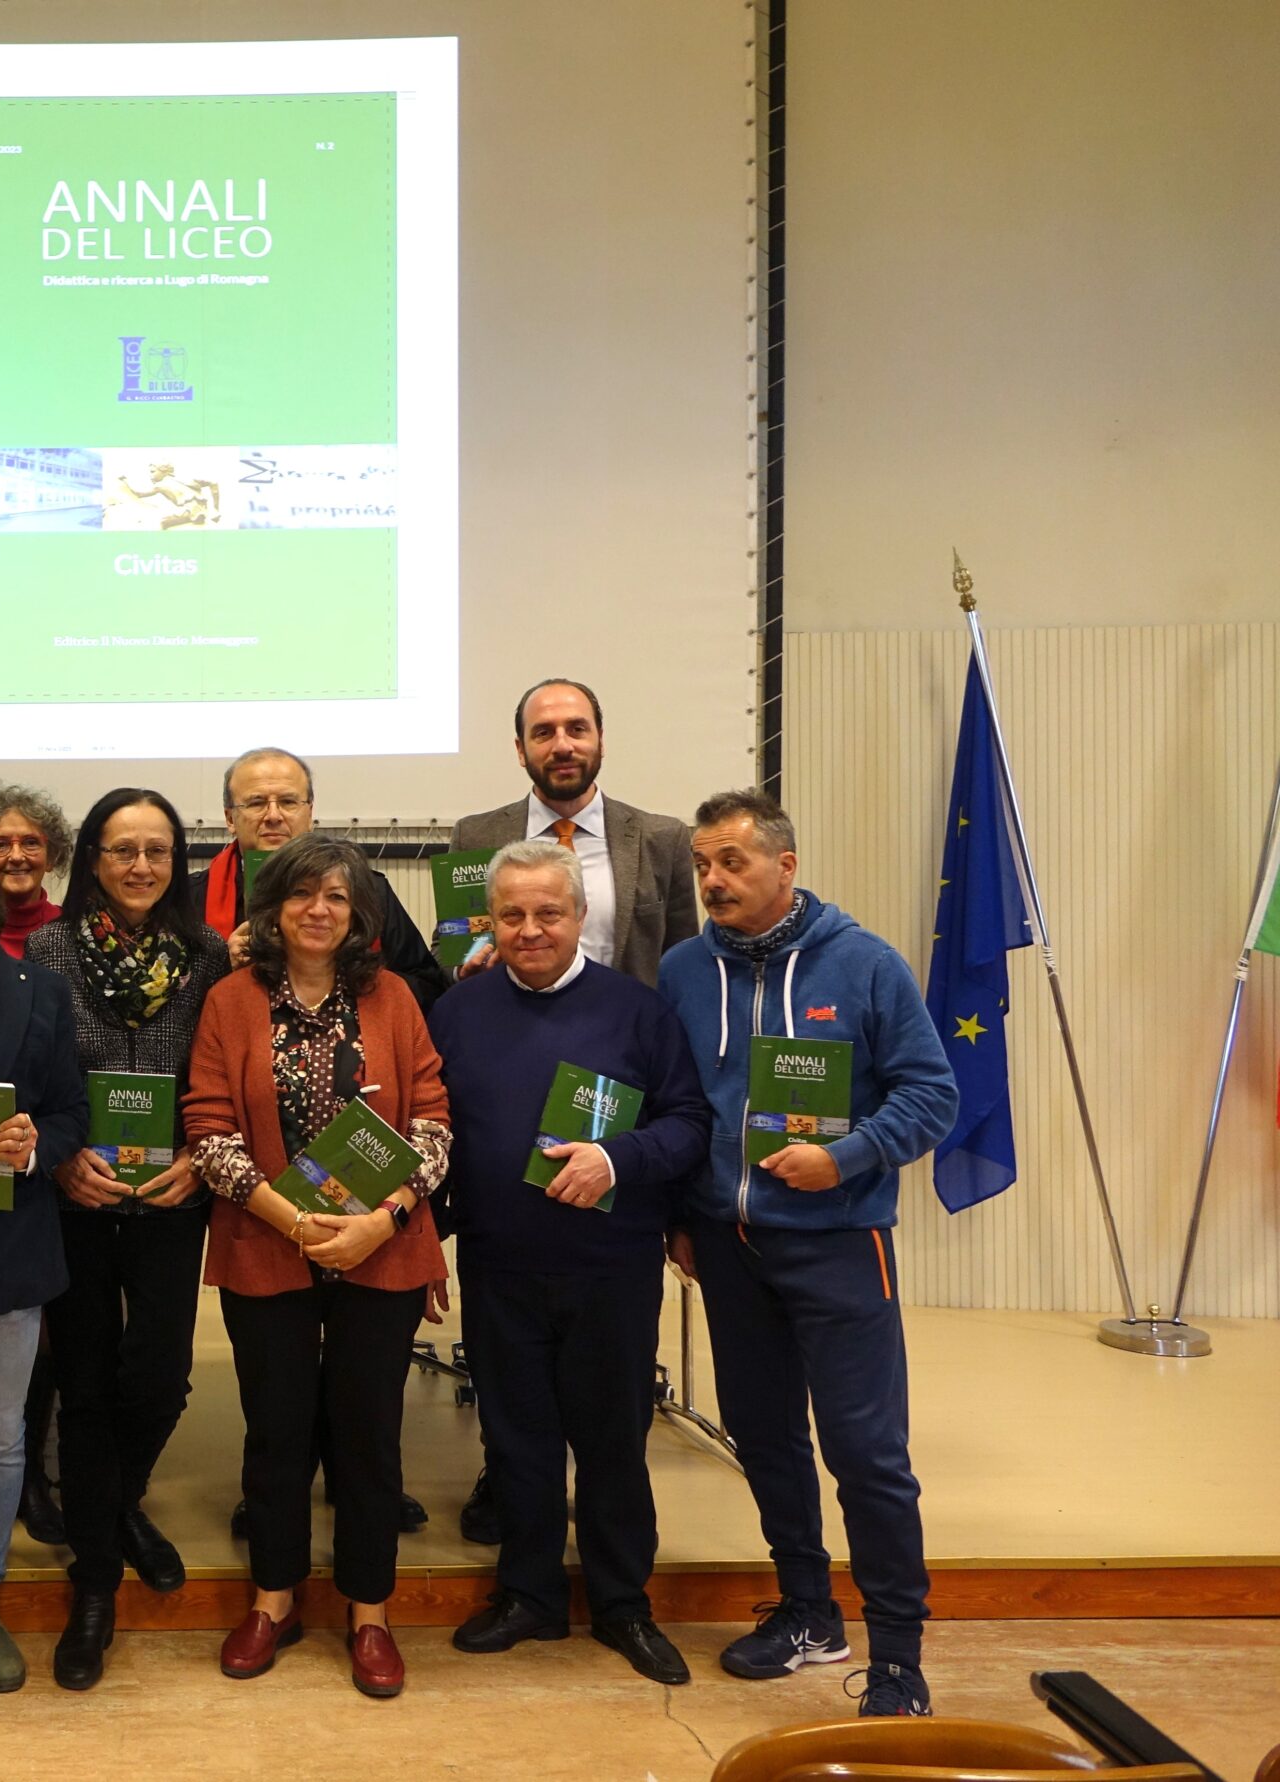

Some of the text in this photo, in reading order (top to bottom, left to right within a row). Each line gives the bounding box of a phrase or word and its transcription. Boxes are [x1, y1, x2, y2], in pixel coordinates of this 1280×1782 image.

[41, 178, 267, 223] ANNALI
[41, 225, 273, 260] DEL LICEO
[42, 274, 100, 286] Didattica
[111, 275, 153, 286] ricerca
[164, 274, 195, 287] Lugo
[196, 274, 209, 285] di
[210, 273, 270, 287] Romagna
[113, 553, 199, 576] Civitas
[111, 635, 150, 646] Nuovo
[452, 863, 488, 876] ANNAL
[452, 872, 488, 884] DEL LICE
[774, 1054, 826, 1068] ANNALI
[774, 1064, 826, 1076] DEL LICEO
[108, 1089, 153, 1101] ANNALI
[573, 1094, 590, 1107] DEL
[575, 1085, 619, 1109] ANNALI
[108, 1099, 153, 1109] DEL LICEO
[350, 1133, 365, 1150] DEL
[365, 1147, 389, 1169] LICEO
[355, 1127, 396, 1163] ANNALI
